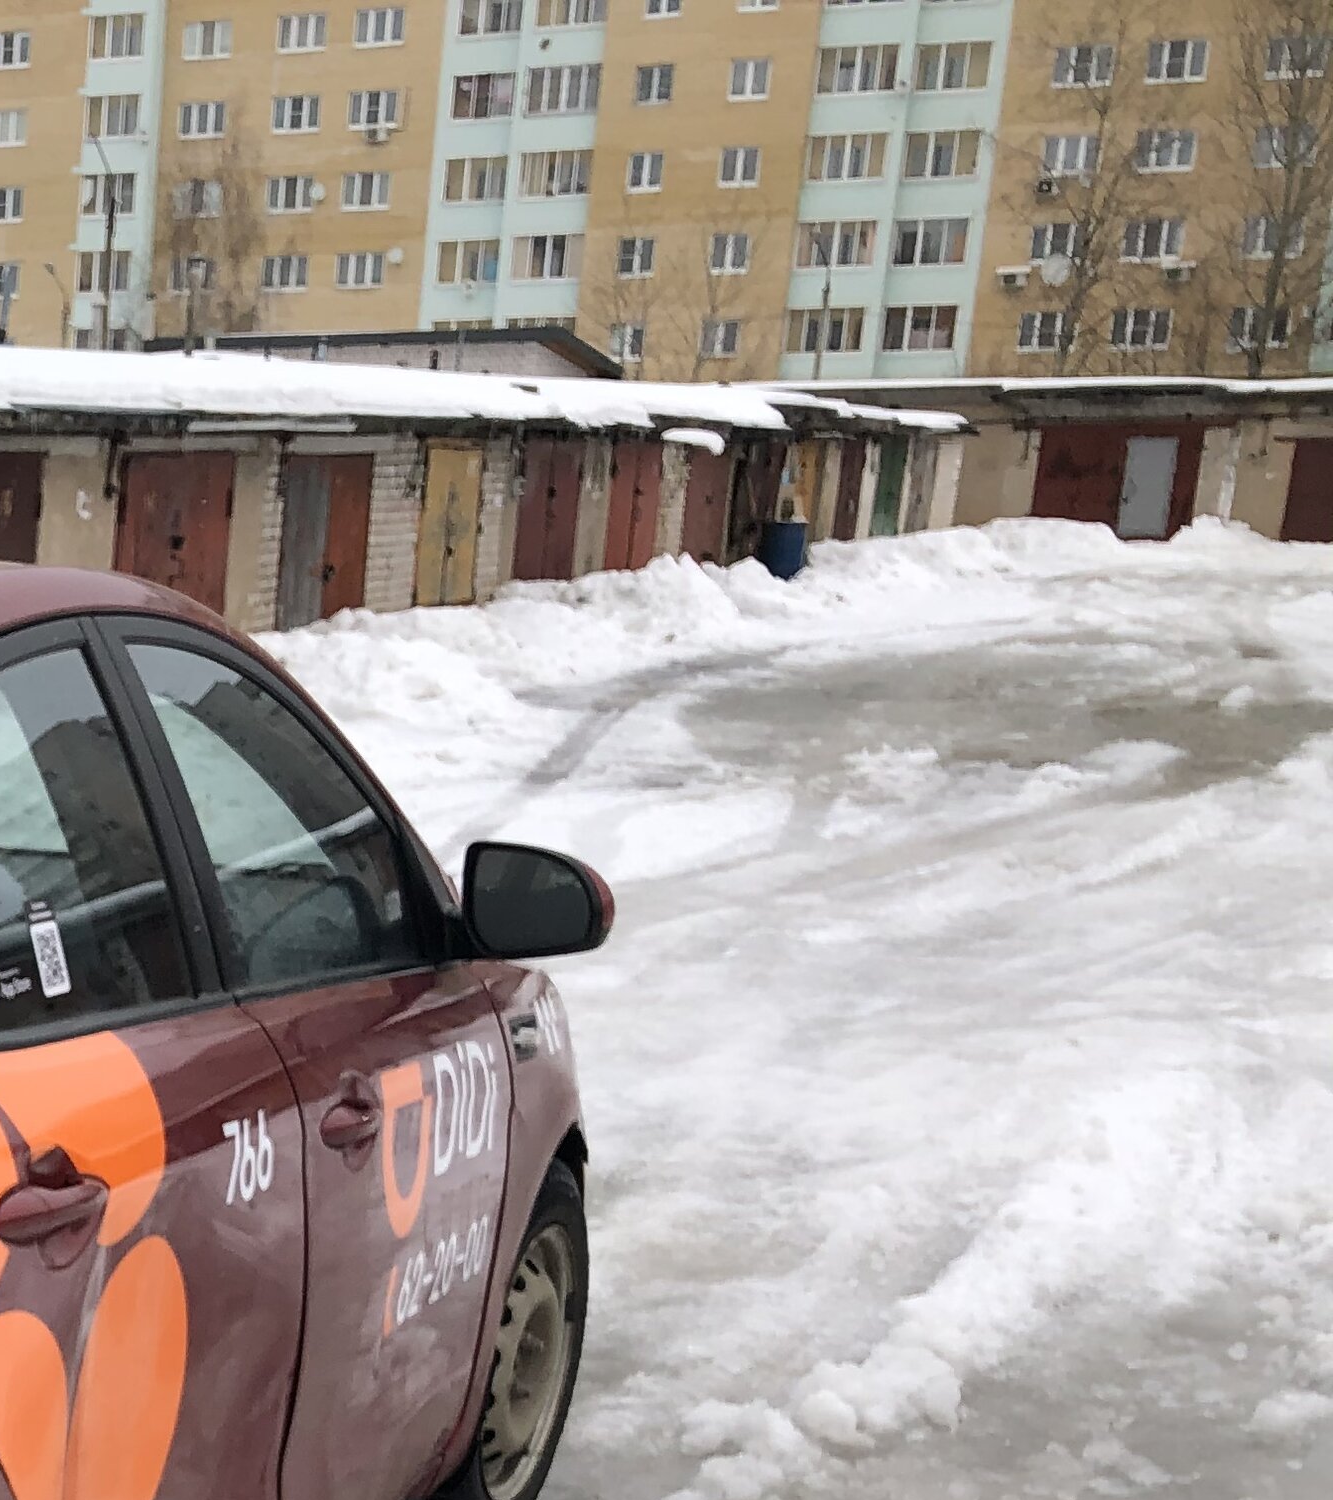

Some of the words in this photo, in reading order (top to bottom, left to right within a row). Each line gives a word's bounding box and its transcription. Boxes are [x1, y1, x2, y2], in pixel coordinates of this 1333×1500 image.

[221, 1108, 274, 1205] 766
[433, 1041, 497, 1177] DiDi
[396, 1214, 489, 1326] 62-20-00
